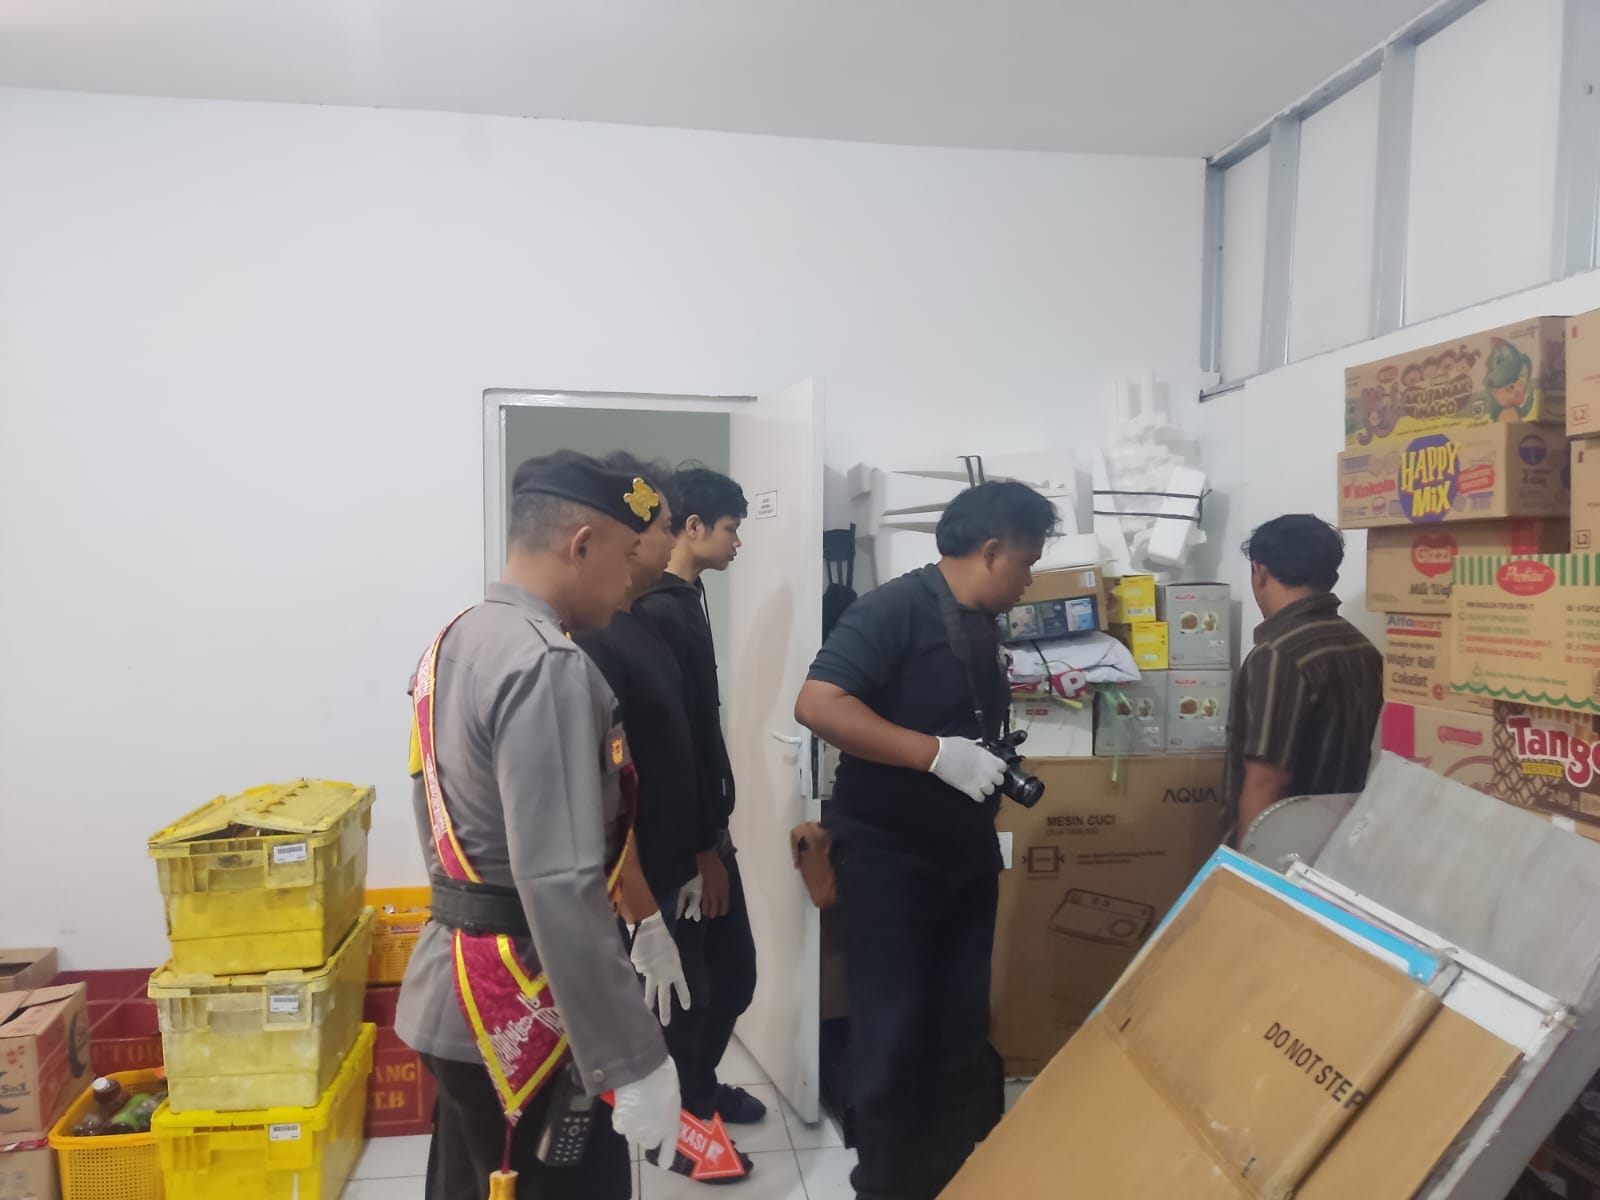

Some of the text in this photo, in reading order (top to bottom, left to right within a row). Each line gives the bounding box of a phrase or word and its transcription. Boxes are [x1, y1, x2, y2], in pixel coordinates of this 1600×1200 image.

[1400, 441, 1460, 493] HAPPY
[1162, 788, 1218, 802] AQUA
[1047, 815, 1115, 826] MESIN CUCI
[1264, 1022, 1367, 1109] DO NOT STEP
[679, 1122, 708, 1152] KASI
